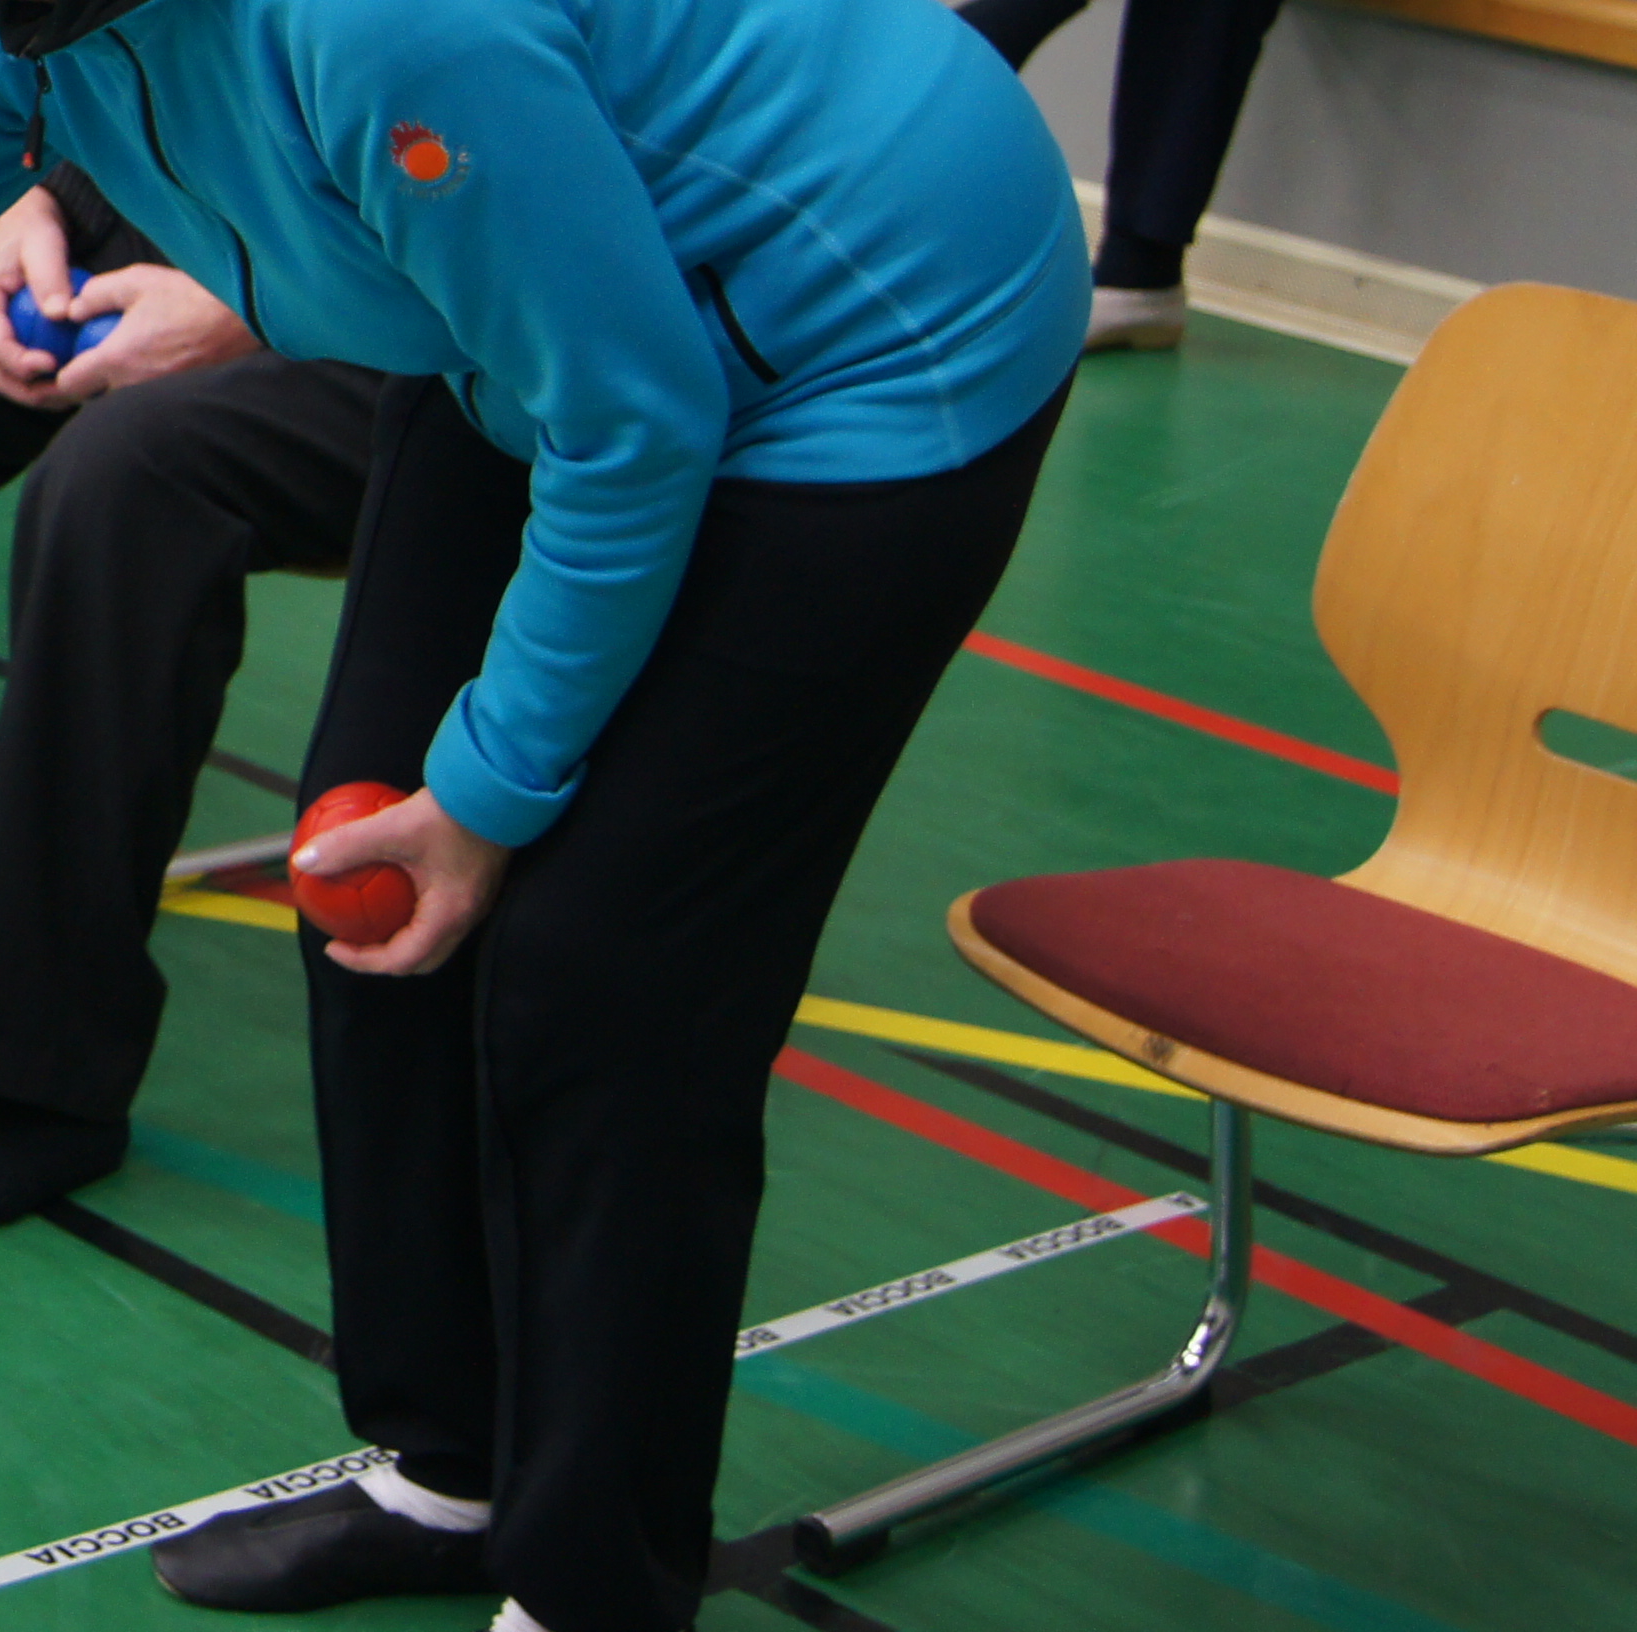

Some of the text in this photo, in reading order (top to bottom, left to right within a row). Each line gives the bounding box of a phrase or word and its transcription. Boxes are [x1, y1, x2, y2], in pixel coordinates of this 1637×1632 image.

[1001, 1216, 1124, 1260] BOCCIA
[827, 1268, 958, 1317] BOCCIA
[244, 1447, 397, 1499] BOCCIA
[25, 1512, 186, 1565] BOCCIA
